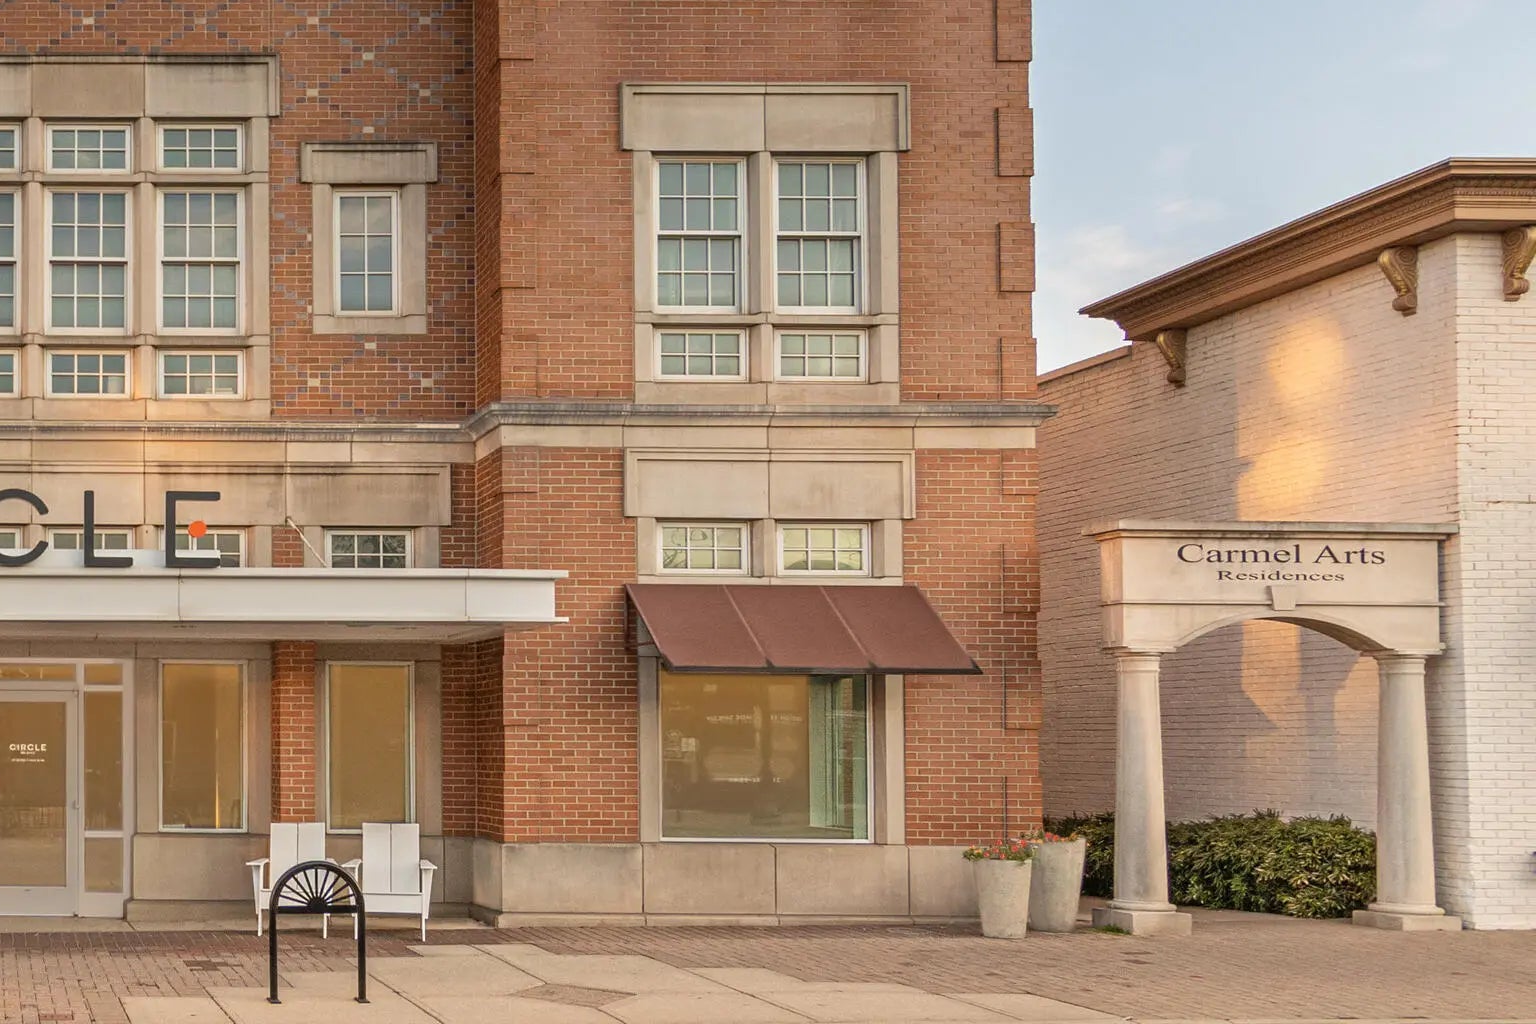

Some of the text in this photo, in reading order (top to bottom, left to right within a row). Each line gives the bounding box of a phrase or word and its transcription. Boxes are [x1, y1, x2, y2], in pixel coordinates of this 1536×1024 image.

[1176, 543, 1386, 565] Carmel Arts
[1217, 570, 1345, 582] Residences
[9, 743, 47, 752] CIRCLE
